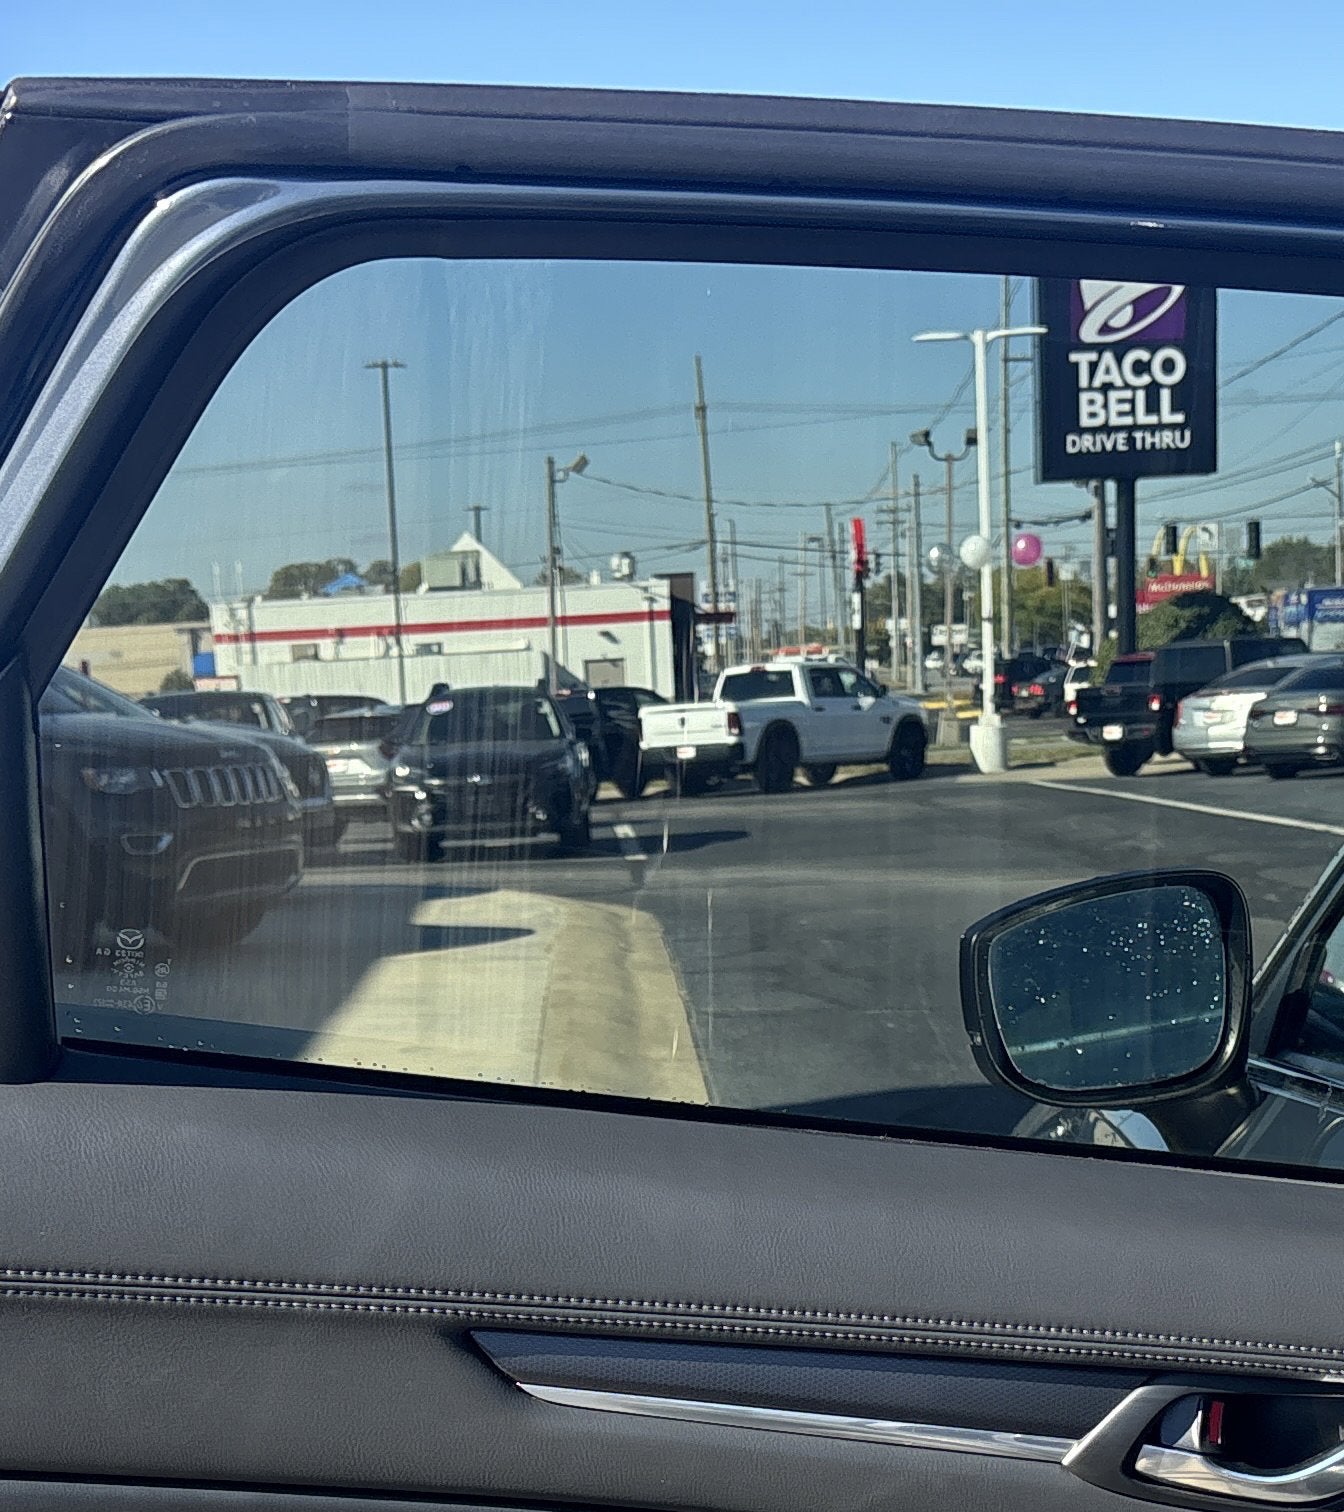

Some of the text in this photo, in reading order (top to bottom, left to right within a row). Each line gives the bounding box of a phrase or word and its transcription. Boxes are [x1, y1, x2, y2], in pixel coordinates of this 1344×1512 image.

[1068, 348, 1187, 389] TACO
[1078, 387, 1186, 428] BELL
[1066, 426, 1192, 454] DRIVE THRU
